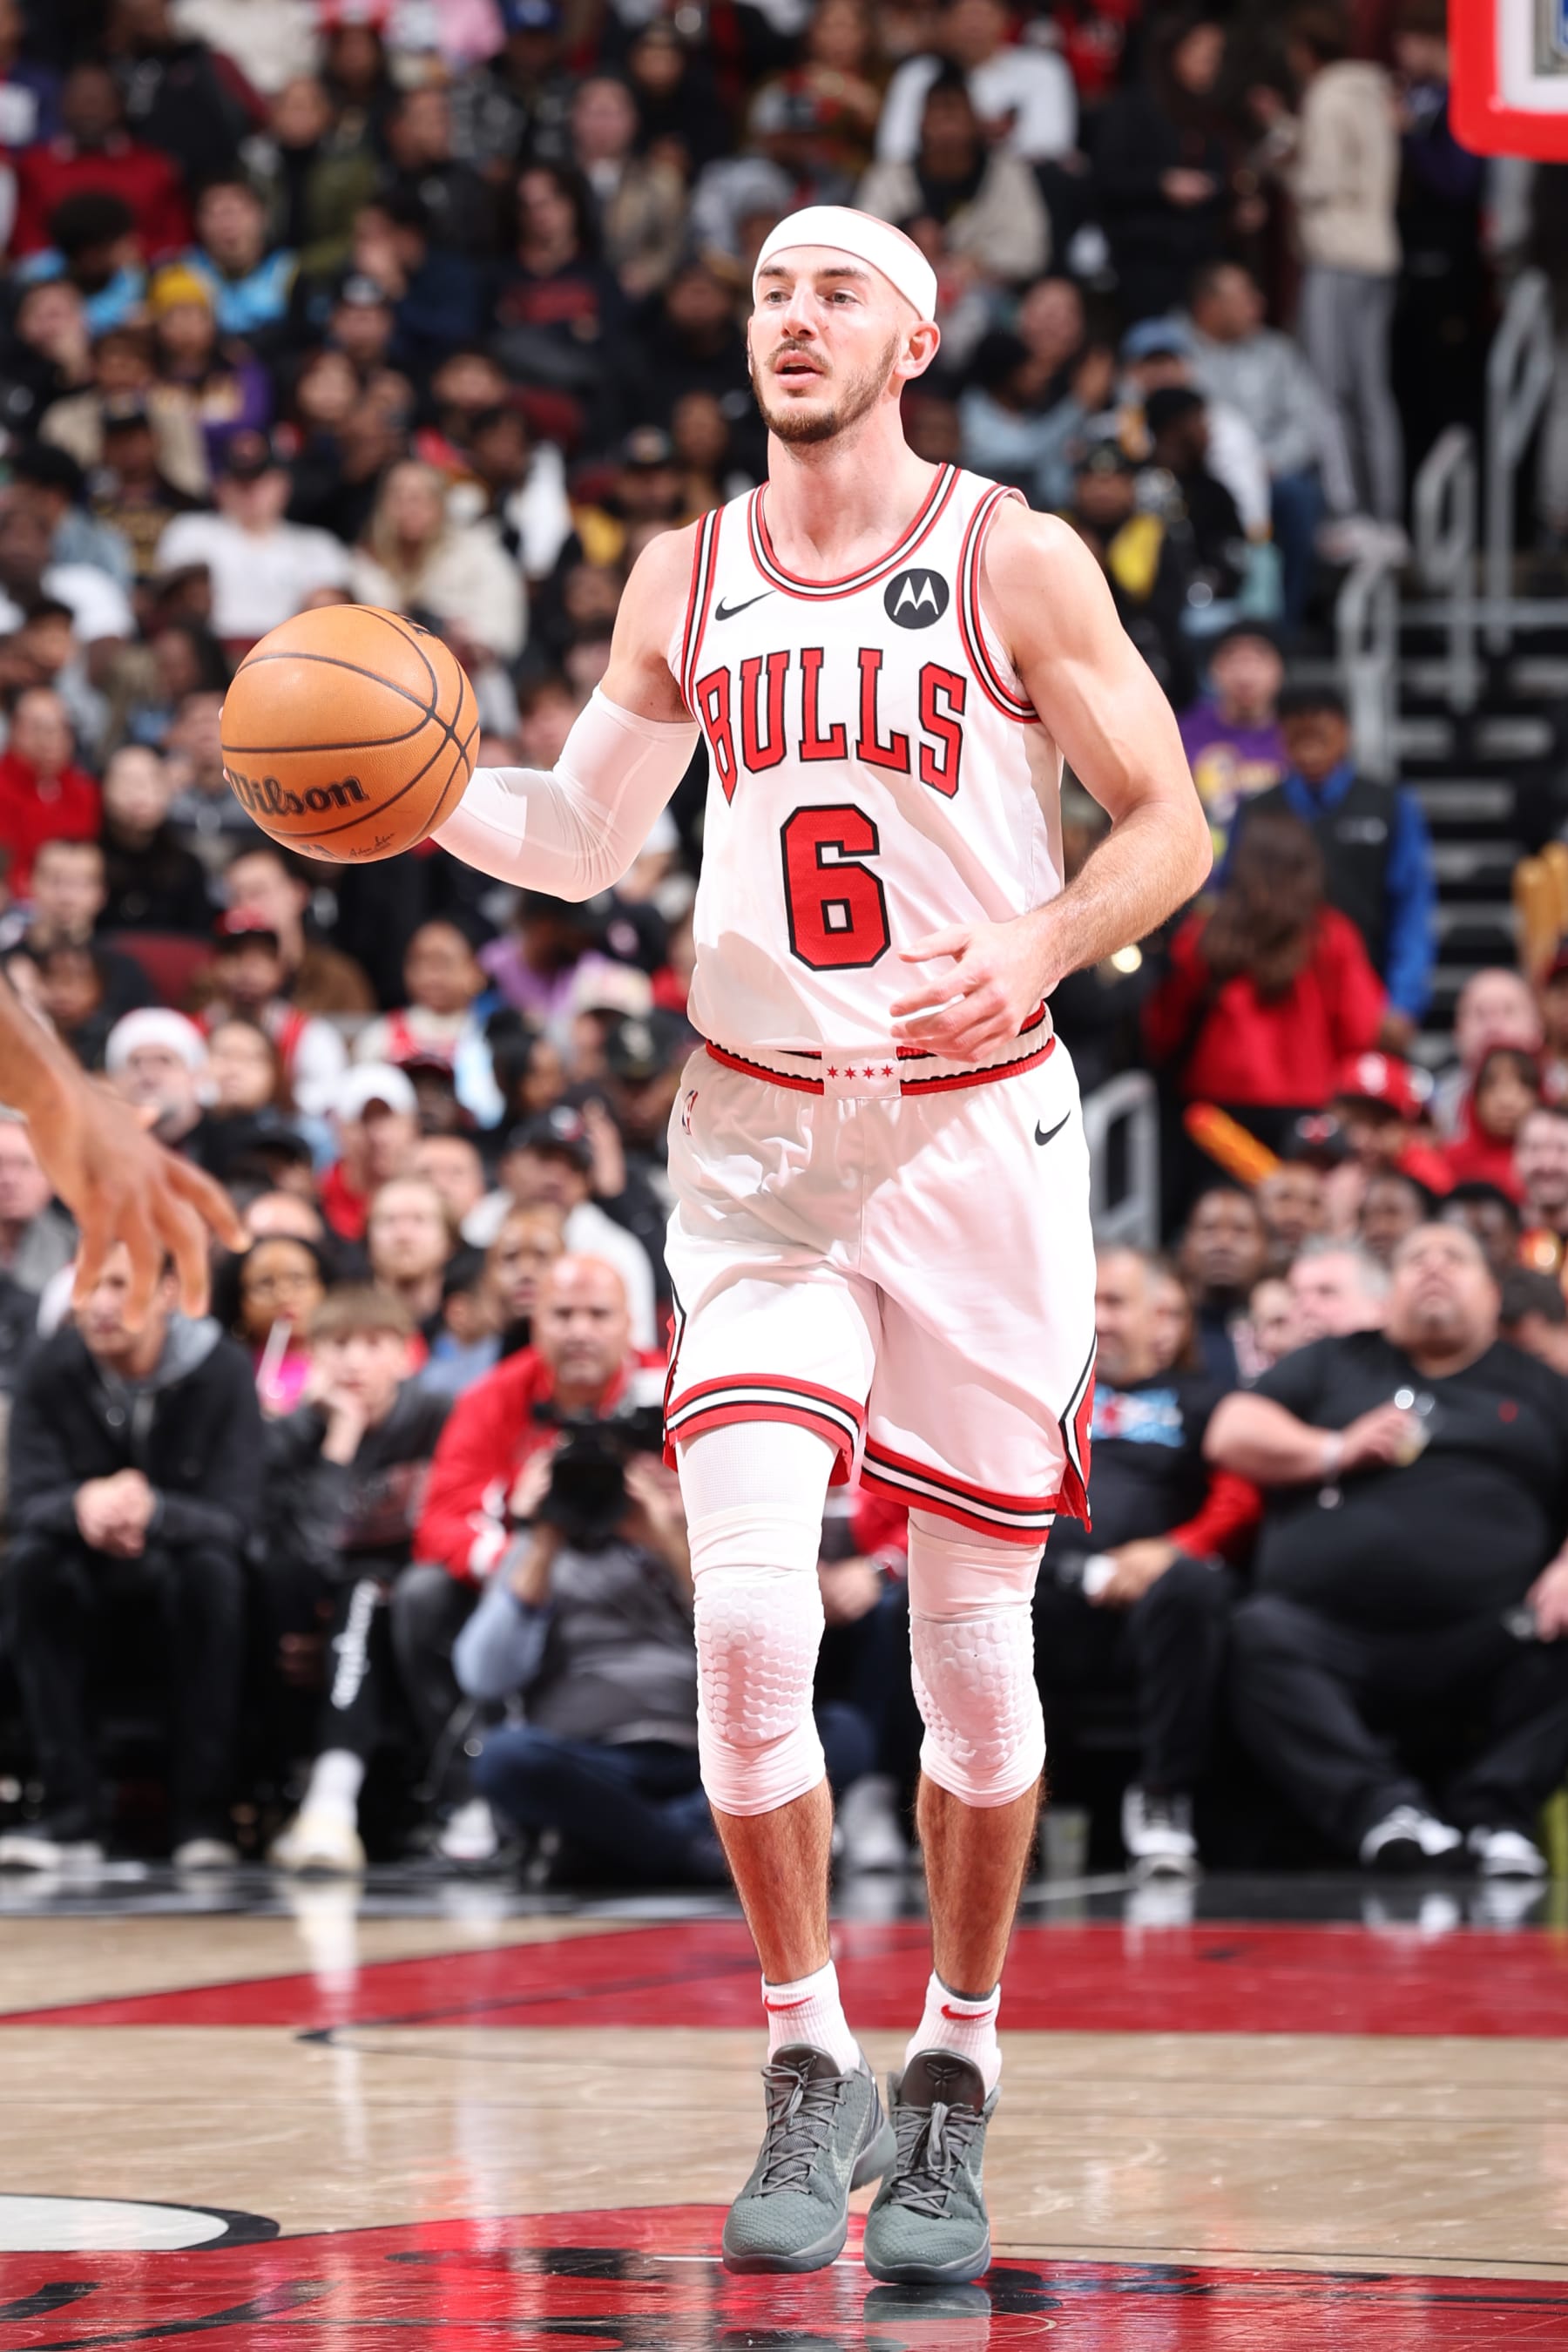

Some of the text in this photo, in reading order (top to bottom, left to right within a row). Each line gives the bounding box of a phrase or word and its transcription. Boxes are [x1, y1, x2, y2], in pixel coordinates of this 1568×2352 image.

[226, 766, 369, 815] Wilson
[696, 646, 967, 806] BULLS
[780, 803, 891, 971] 6
